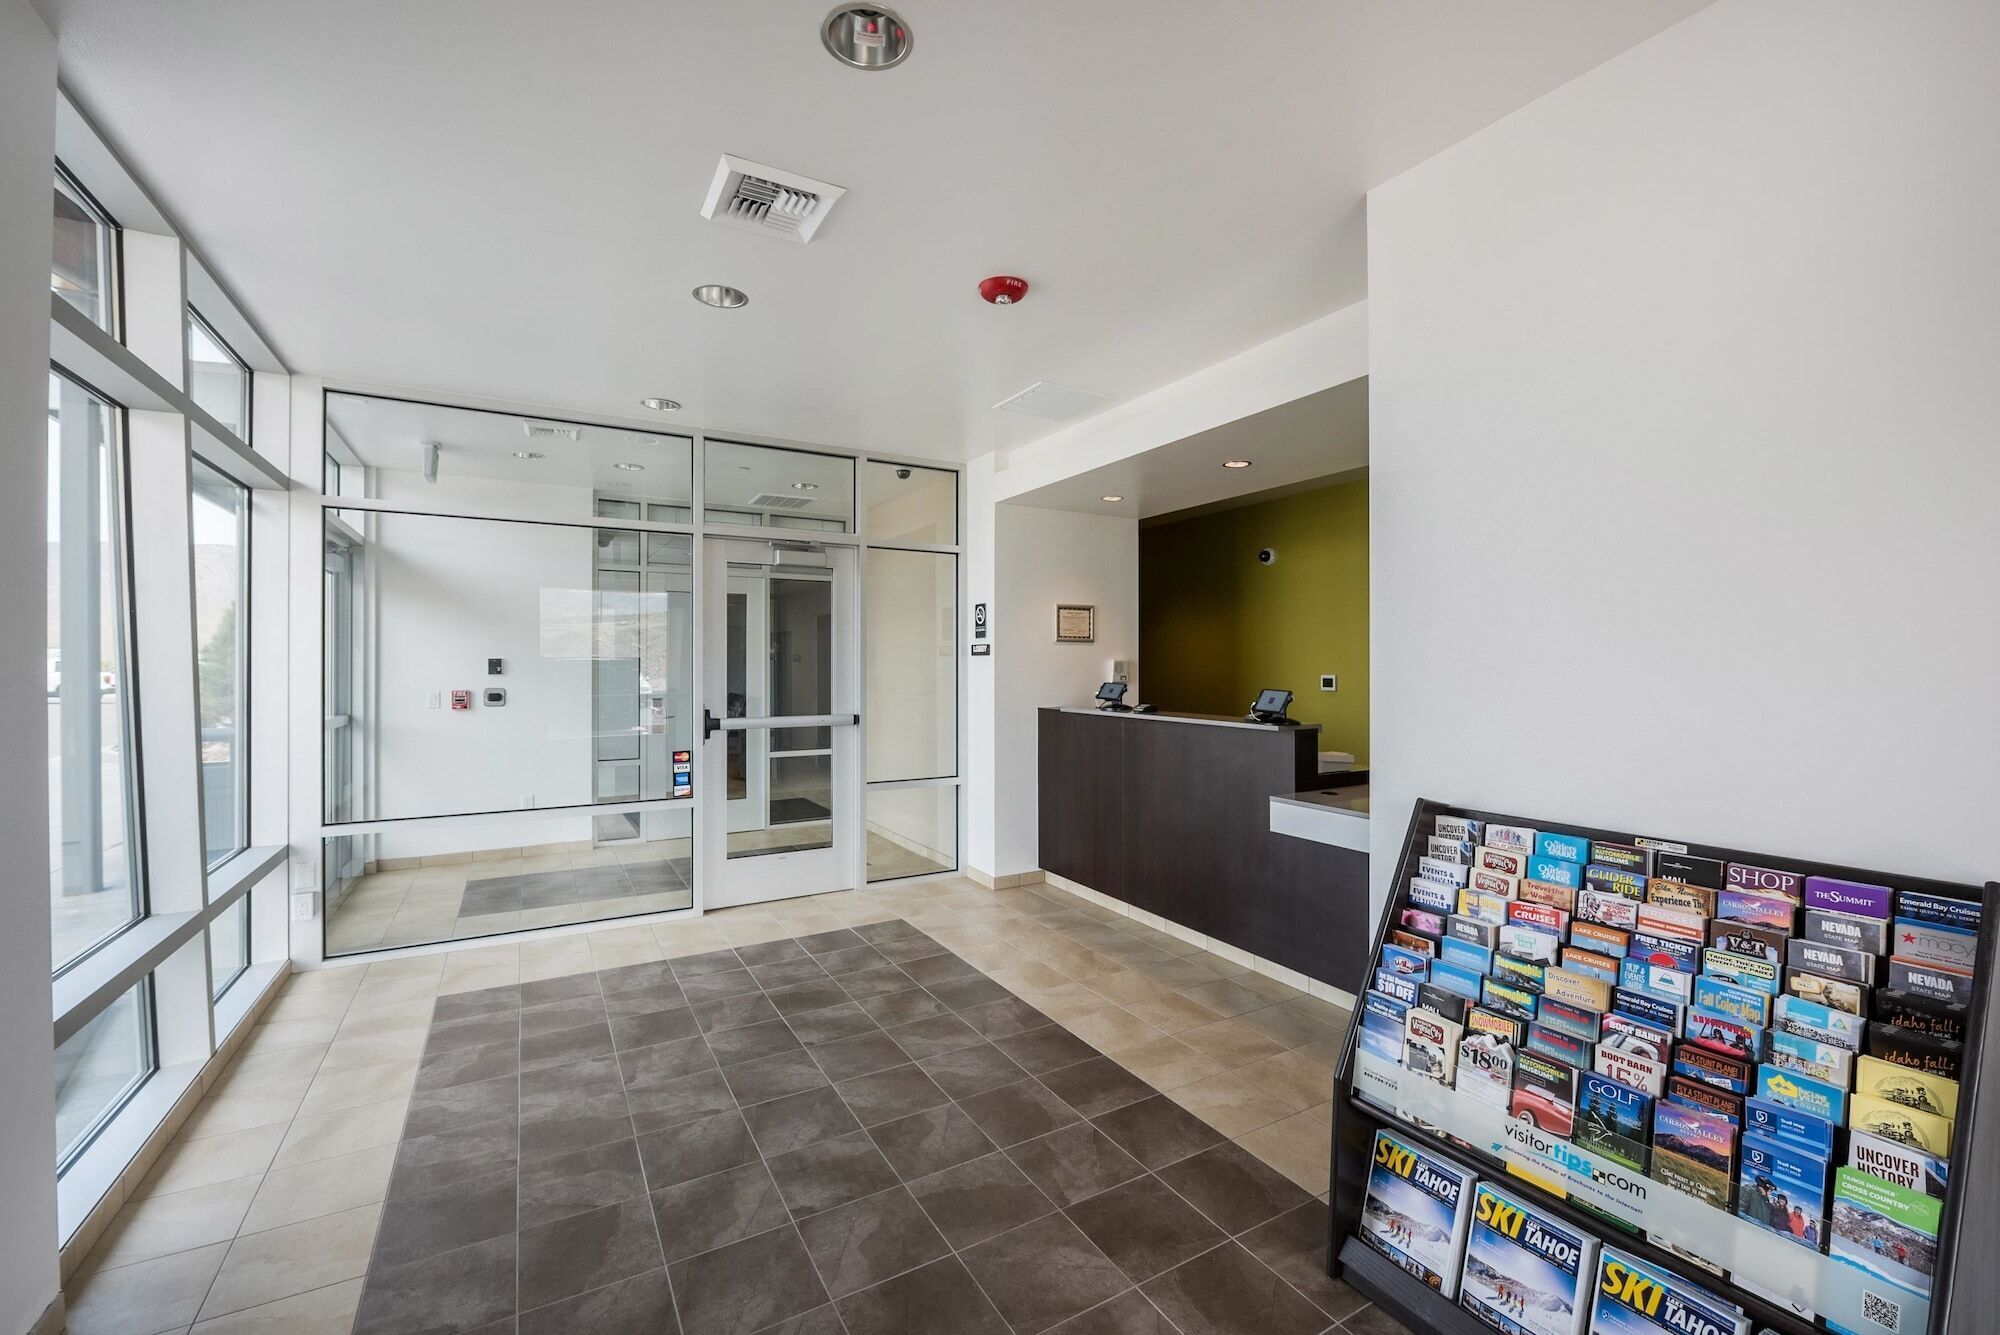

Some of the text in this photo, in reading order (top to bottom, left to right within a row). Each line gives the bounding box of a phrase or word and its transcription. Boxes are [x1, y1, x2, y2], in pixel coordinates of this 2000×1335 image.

[1006, 280, 1022, 288] FIRE
[1438, 824, 1466, 834] UNCOVER
[1430, 844, 1458, 855] UNCOVER
[1595, 848, 1641, 862] AUTOMOBILE
[1595, 854, 1630, 865] MUSEUMS
[1422, 866, 1448, 878] EVENTS
[1589, 868, 1634, 885] GLIDER
[1730, 867, 1794, 891] SHOP
[1413, 888, 1438, 900] EVENTS
[1613, 882, 1640, 896] RIDE
[1814, 890, 1874, 906] THE SUMMIT
[1650, 892, 1690, 908] Experience
[1722, 900, 1784, 918] CARSON VALLEY
[1900, 897, 1981, 918] Emerald Bay Cruises
[1514, 910, 1556, 925] CRUISES
[1456, 922, 1478, 936] NEVADA
[1574, 926, 1620, 942] LAKE CRUISES
[1821, 920, 1862, 938] NEVADA
[1824, 933, 1842, 942] STATE
[1635, 934, 1658, 946] FREE
[1660, 940, 1694, 954] TICKET
[1728, 936, 1764, 953] V&T
[1918, 938, 1976, 958] macy
[1496, 954, 1543, 978] Snowmobile
[1565, 952, 1610, 968] LAKE CRUISES
[1709, 954, 1734, 963] TAHOE
[1736, 960, 1754, 968] TREE
[1804, 948, 1844, 966] NEVADA
[1806, 962, 1824, 970] STATE
[1706, 958, 1774, 978] ADVENTURE PARKS
[1548, 972, 1580, 986] Discover
[1624, 972, 1646, 984] EVENTS
[1908, 972, 1954, 992] NEVADA
[1378, 980, 1414, 1002] $10 OFF
[1486, 980, 1532, 1006] Snowmobile
[1556, 990, 1596, 1004] Adventure
[1911, 986, 1952, 998] STATE MAP
[1422, 1003, 1440, 1016] MALL
[1617, 992, 1640, 1004] Emerald
[1640, 999, 1651, 1008] Bay
[1652, 1003, 1674, 1014] Cruises
[1699, 990, 1760, 1020] Fall Color Map
[1472, 1015, 1512, 1032] SNOWMOBILE!
[1609, 1020, 1661, 1043] BOOT BARN
[1891, 1015, 1960, 1034] idaho falls
[1520, 1057, 1566, 1079] AUTOMOBILE
[1601, 1050, 1653, 1074] BOOT BARN
[1680, 1051, 1690, 1060] FLY
[1696, 1056, 1716, 1070] STUNT
[1717, 1062, 1738, 1078] PLANE!
[1772, 1052, 1788, 1062] THE
[1788, 1056, 1807, 1066] BEST
[1884, 1051, 1955, 1070] idaho falls
[1520, 1062, 1554, 1080] MUSEUMS
[1588, 1080, 1640, 1105] GOLF
[1676, 1084, 1686, 1096] FLY
[1693, 1092, 1713, 1104] STUNT
[1660, 1115, 1724, 1144] CARSON VALLEY
[1794, 1122, 1805, 1130] Map
[1376, 1137, 1417, 1182] SKI
[1776, 1160, 1789, 1168] Trail
[1790, 1164, 1802, 1172] Map
[1856, 1146, 1920, 1178] UNCOVER
[1414, 1165, 1459, 1202] TAHOE
[1504, 1145, 1530, 1161] Delivering
[1531, 1158, 1540, 1166] the
[1541, 1161, 1559, 1174] Power
[1567, 1174, 1596, 1192] Brochures
[1604, 1192, 1614, 1201] the
[1616, 1198, 1643, 1214] Internet!
[1842, 1174, 1896, 1198] TAHOE DONNER
[1842, 1181, 1868, 1196] CROSS
[1868, 1190, 1910, 1211] COUNTRY
[1476, 1192, 1526, 1240] SKI
[1526, 1220, 1540, 1230] LAKE
[1524, 1224, 1580, 1267] TAHOE
[1601, 1262, 1664, 1317] SKI
[1666, 1296, 1684, 1310] LAKE
